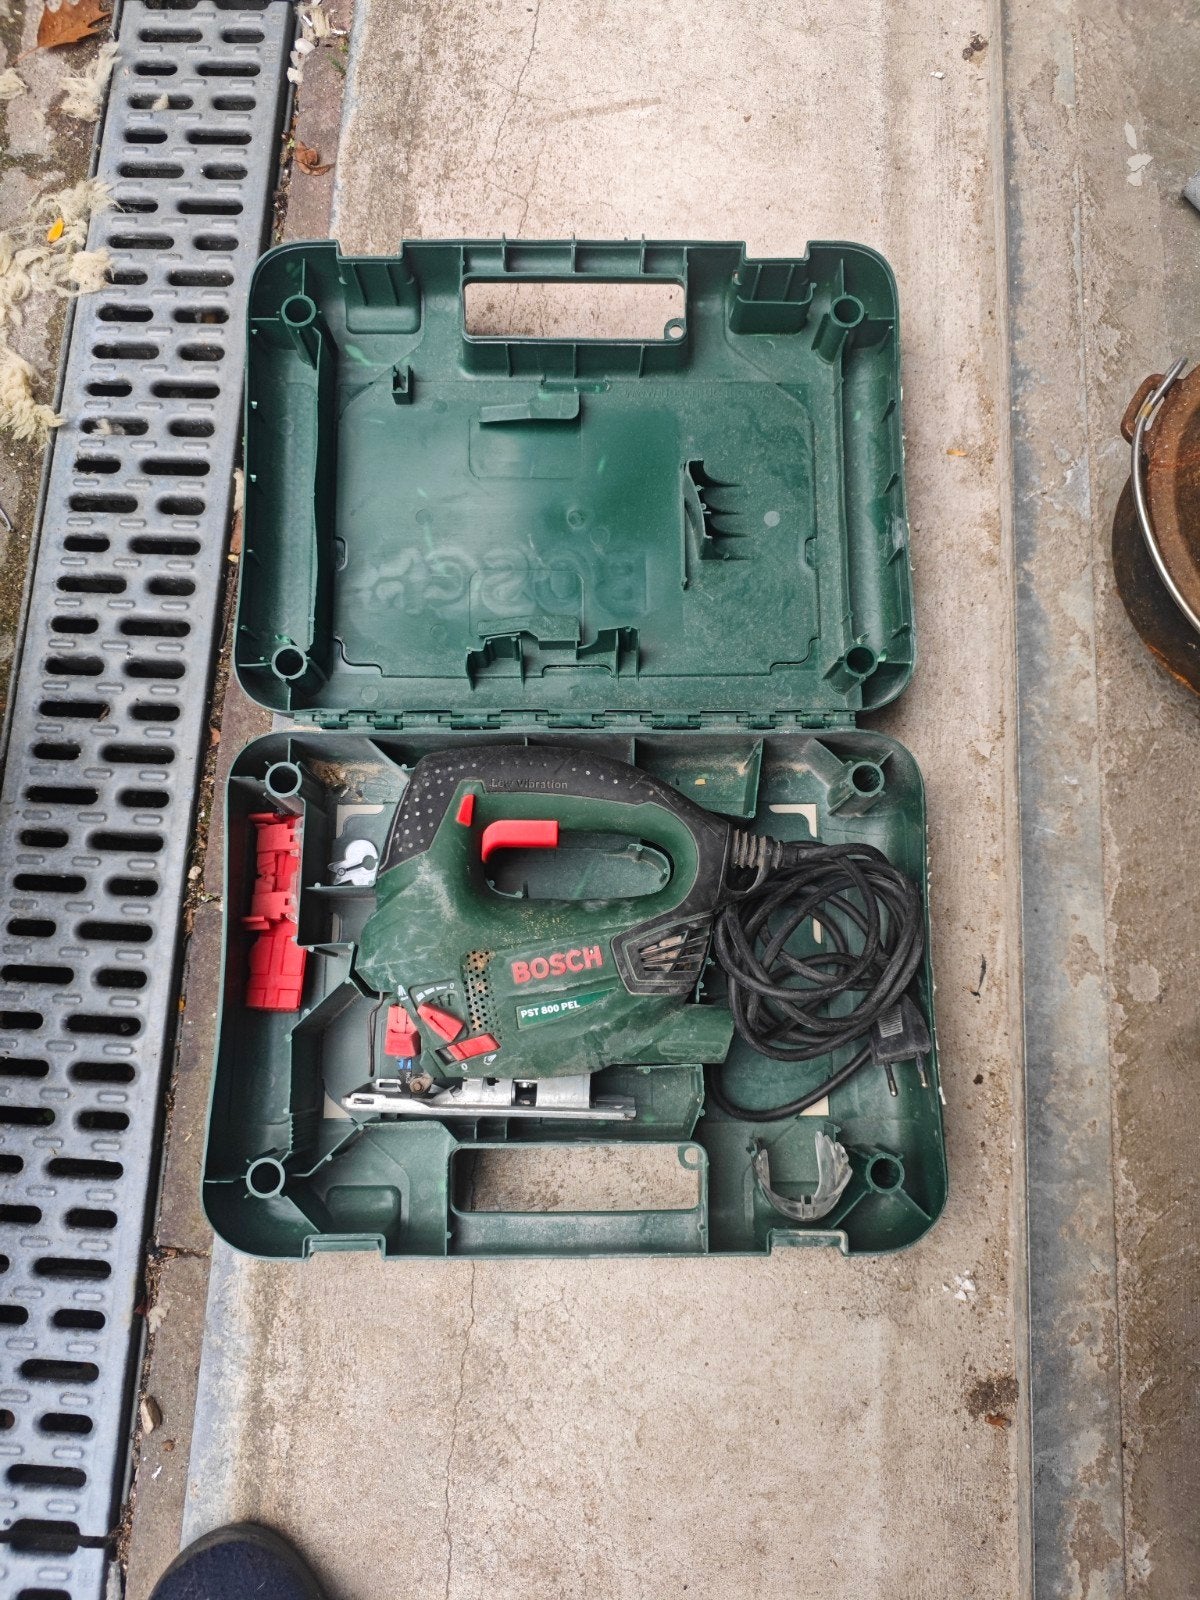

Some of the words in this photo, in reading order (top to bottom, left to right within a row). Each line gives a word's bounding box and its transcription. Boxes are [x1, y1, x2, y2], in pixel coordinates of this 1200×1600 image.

[516, 779, 568, 789] Vibration
[511, 945, 603, 985] BOSCH
[520, 1007, 540, 1019] PST
[541, 1004, 560, 1015] 800
[560, 1000, 581, 1011] PEL
